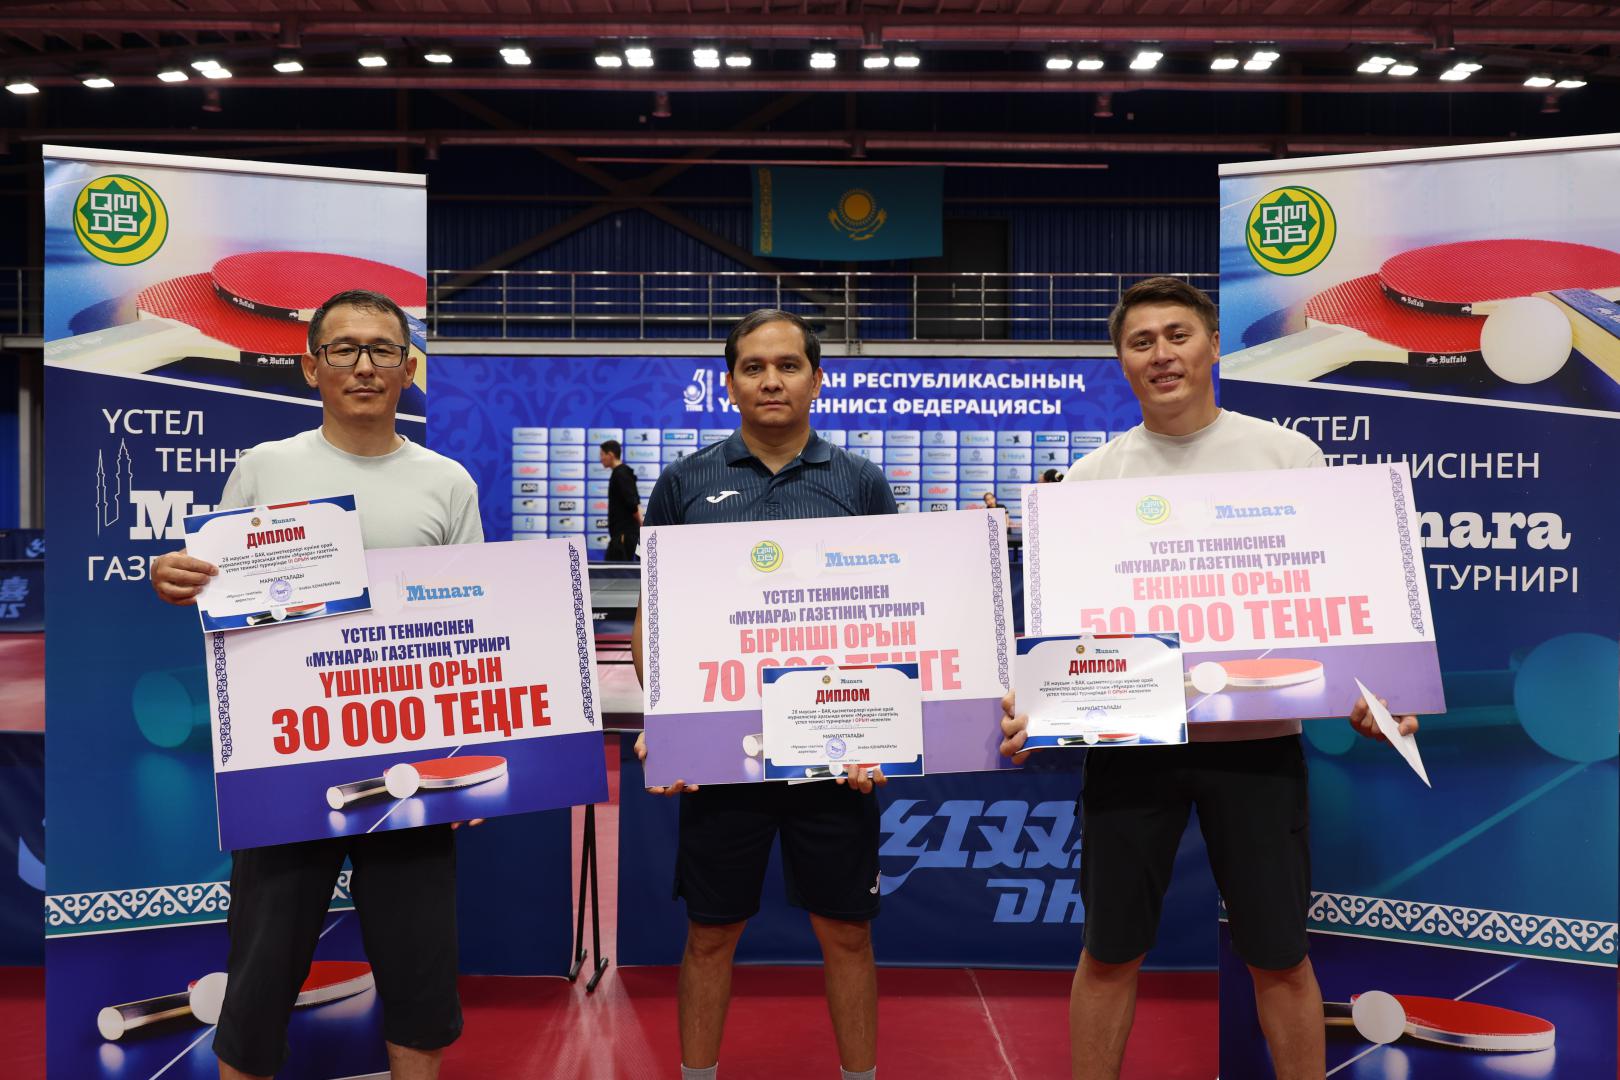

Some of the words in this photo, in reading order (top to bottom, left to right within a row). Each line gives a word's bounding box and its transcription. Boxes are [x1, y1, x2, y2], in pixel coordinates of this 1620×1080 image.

[90, 192, 138, 213] QM
[90, 214, 138, 233] DB
[1262, 205, 1307, 224] QM
[1262, 226, 1307, 244] DB
[269, 356, 295, 365] Buffalo
[1439, 356, 1467, 364] Buffalo
[854, 371, 1085, 393] РЕСПУБЛИКАСЫНЫҢ
[810, 398, 888, 415] ЕННИСІ
[893, 397, 1061, 418] ФЕДЕРАЦИЯСЫ
[102, 409, 204, 435] ҮСТЕЛ
[1215, 502, 1297, 519] Munara
[247, 526, 306, 549] ДИПЛОМ
[1416, 511, 1572, 550] nara
[1149, 539, 1195, 555] ҮСТЕЛ
[1196, 535, 1286, 553] ТЕННИСІНЕН
[825, 550, 900, 568] Munara
[1188, 554, 1263, 573] ГАЗЕТІНІҢ
[1264, 550, 1326, 568] ТУРНИРІ
[1132, 575, 1225, 601] ЕКІНШІ
[1232, 570, 1311, 595] ОРЫН
[1430, 564, 1578, 593] ТУРНИРІ
[406, 582, 484, 602] Munara
[763, 589, 804, 605] ҮСТЕЛ
[807, 584, 890, 603] ТЕННИСІНЕН
[799, 604, 868, 623] ГАЗЕТІНІҢ
[869, 602, 925, 619] ТУРНИРІ
[1148, 602, 1234, 644] 000
[1243, 595, 1374, 643] ТЕҢГЕ
[341, 624, 387, 644] ҮСТЕЛ
[389, 619, 474, 640] ТЕННИСІНЕН
[740, 624, 837, 654] БІРІНШІ
[844, 621, 916, 649] ОРЫН
[305, 647, 378, 668] «МҰНАРА»
[381, 640, 452, 661] ГАЗЕТІНІҢ
[454, 636, 510, 655] ТУРНИРІ
[318, 664, 423, 699] ҮШІНШІ
[429, 657, 502, 688] ОРЫН
[1069, 659, 1127, 676] ДИПЛОМ
[699, 660, 746, 703] 70
[816, 688, 870, 705] ДИПЛОМ
[271, 704, 330, 755] 30
[341, 696, 427, 748] 000
[434, 684, 551, 737] ТЕҢГЕ
[986, 879, 1085, 923] DH
